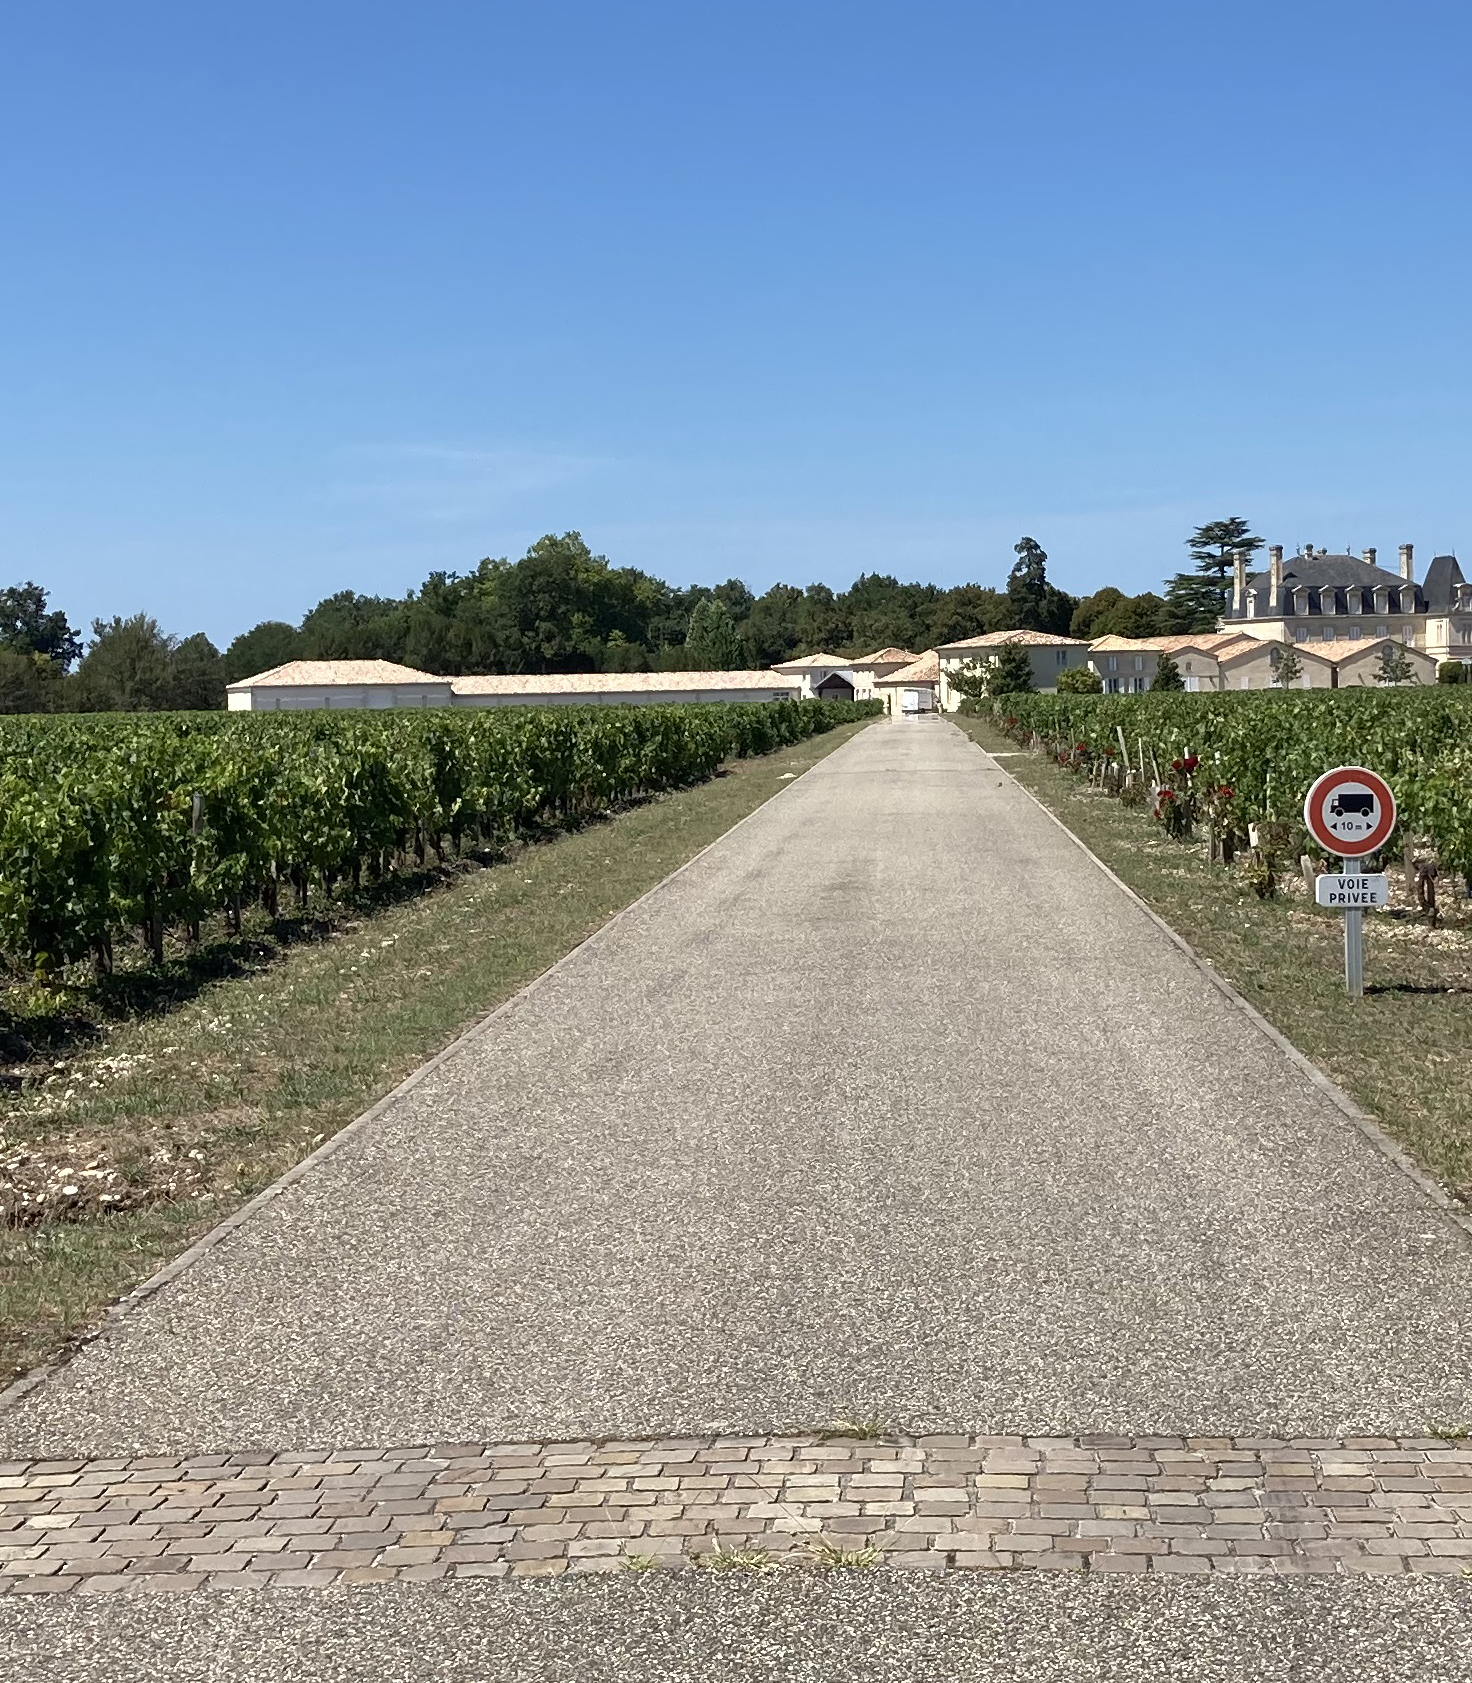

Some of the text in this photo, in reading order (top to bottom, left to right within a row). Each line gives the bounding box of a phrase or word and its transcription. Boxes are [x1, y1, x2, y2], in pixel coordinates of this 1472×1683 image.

[1341, 821, 1353, 830] 10
[1337, 878, 1369, 890] VOIE
[1329, 892, 1378, 904] PRIVEE
